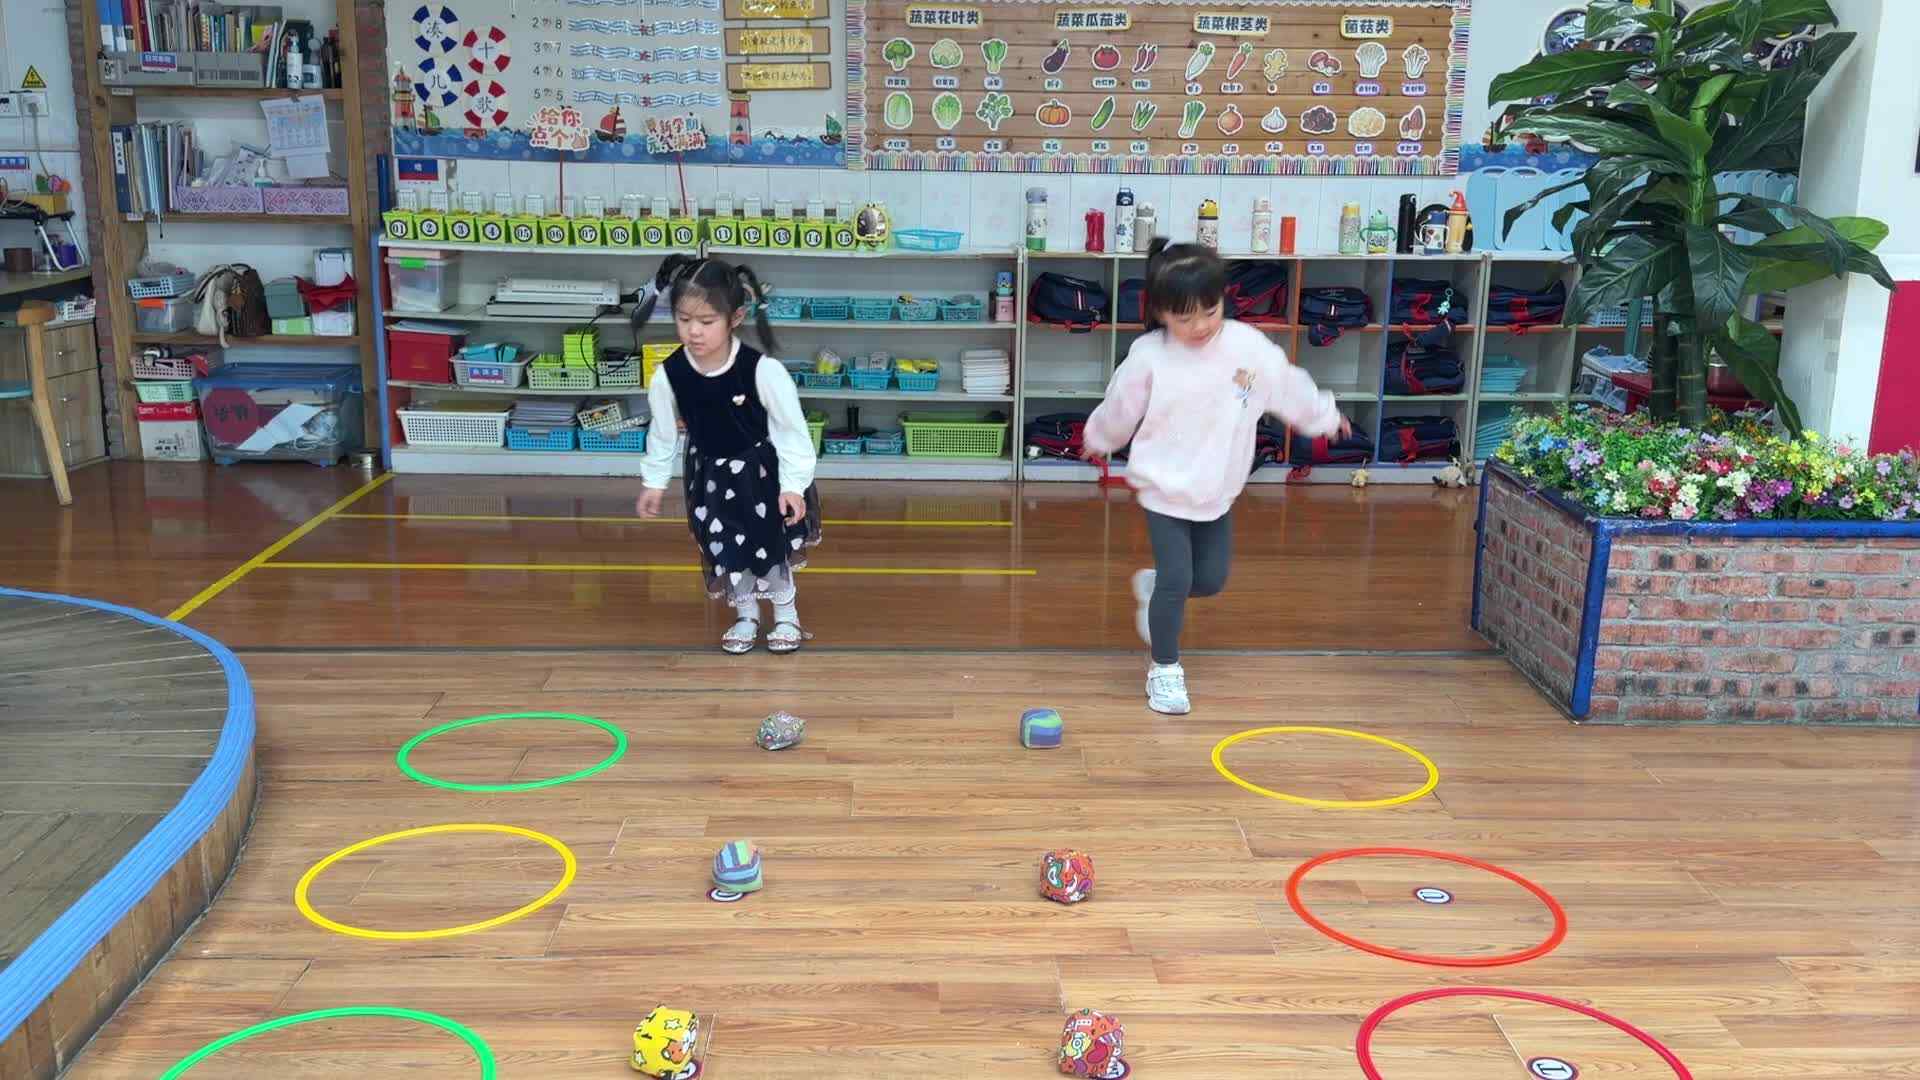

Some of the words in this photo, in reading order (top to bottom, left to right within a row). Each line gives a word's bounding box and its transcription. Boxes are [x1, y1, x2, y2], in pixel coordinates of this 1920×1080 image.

[909, 10, 979, 25] 蔬菜花叶类
[1056, 12, 1127, 27] 蔬菜瓜茄类
[1197, 15, 1268, 32] 蔬菜根茎类
[1344, 19, 1390, 35] 菌菇类
[538, 108, 581, 128] 给你
[391, 224, 405, 235] 01
[517, 229, 529, 239] 05
[549, 229, 562, 239] 06
[582, 229, 595, 239] 07
[678, 230, 690, 240] 10
[717, 229, 729, 240] 11
[746, 229, 759, 240] 12
[613, 230, 627, 241] 08
[646, 230, 659, 241] 09
[776, 231, 788, 241] 13
